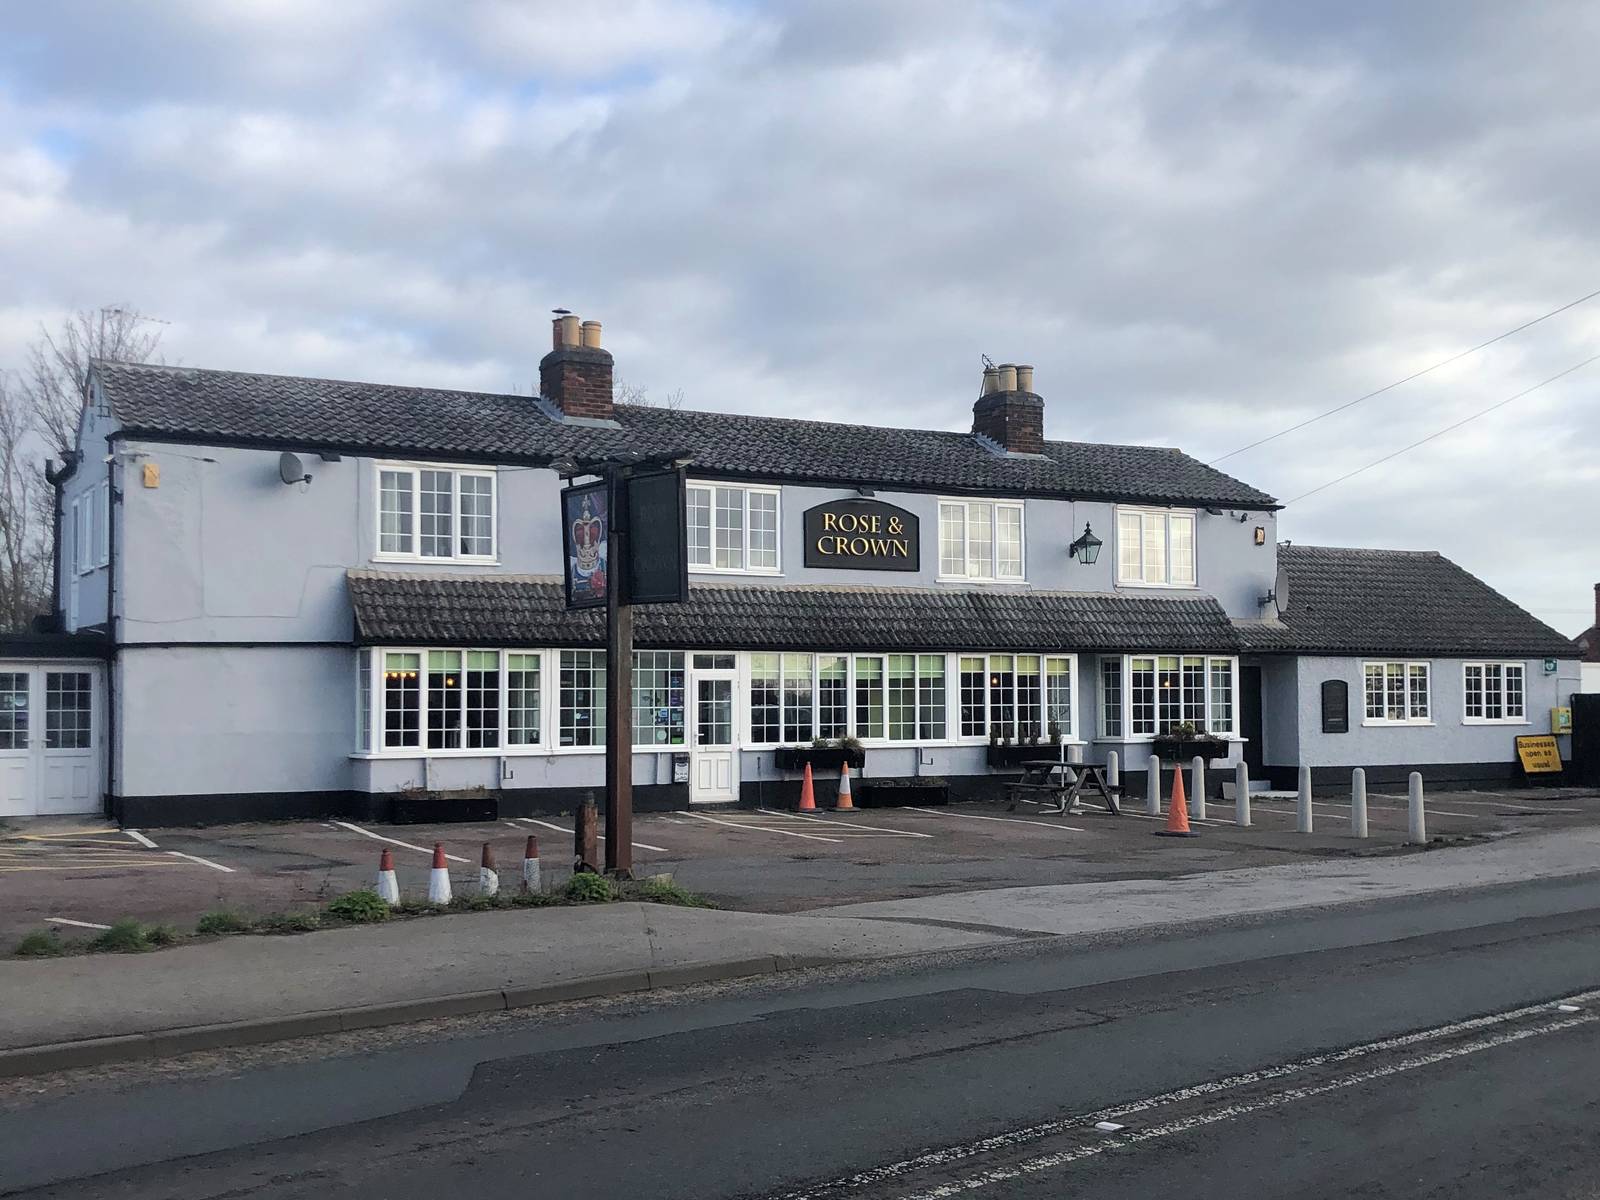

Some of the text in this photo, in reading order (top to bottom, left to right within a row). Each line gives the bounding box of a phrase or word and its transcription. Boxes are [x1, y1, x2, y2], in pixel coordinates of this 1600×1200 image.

[823, 512, 904, 535] ROSE &
[817, 535, 909, 557] CROWN
